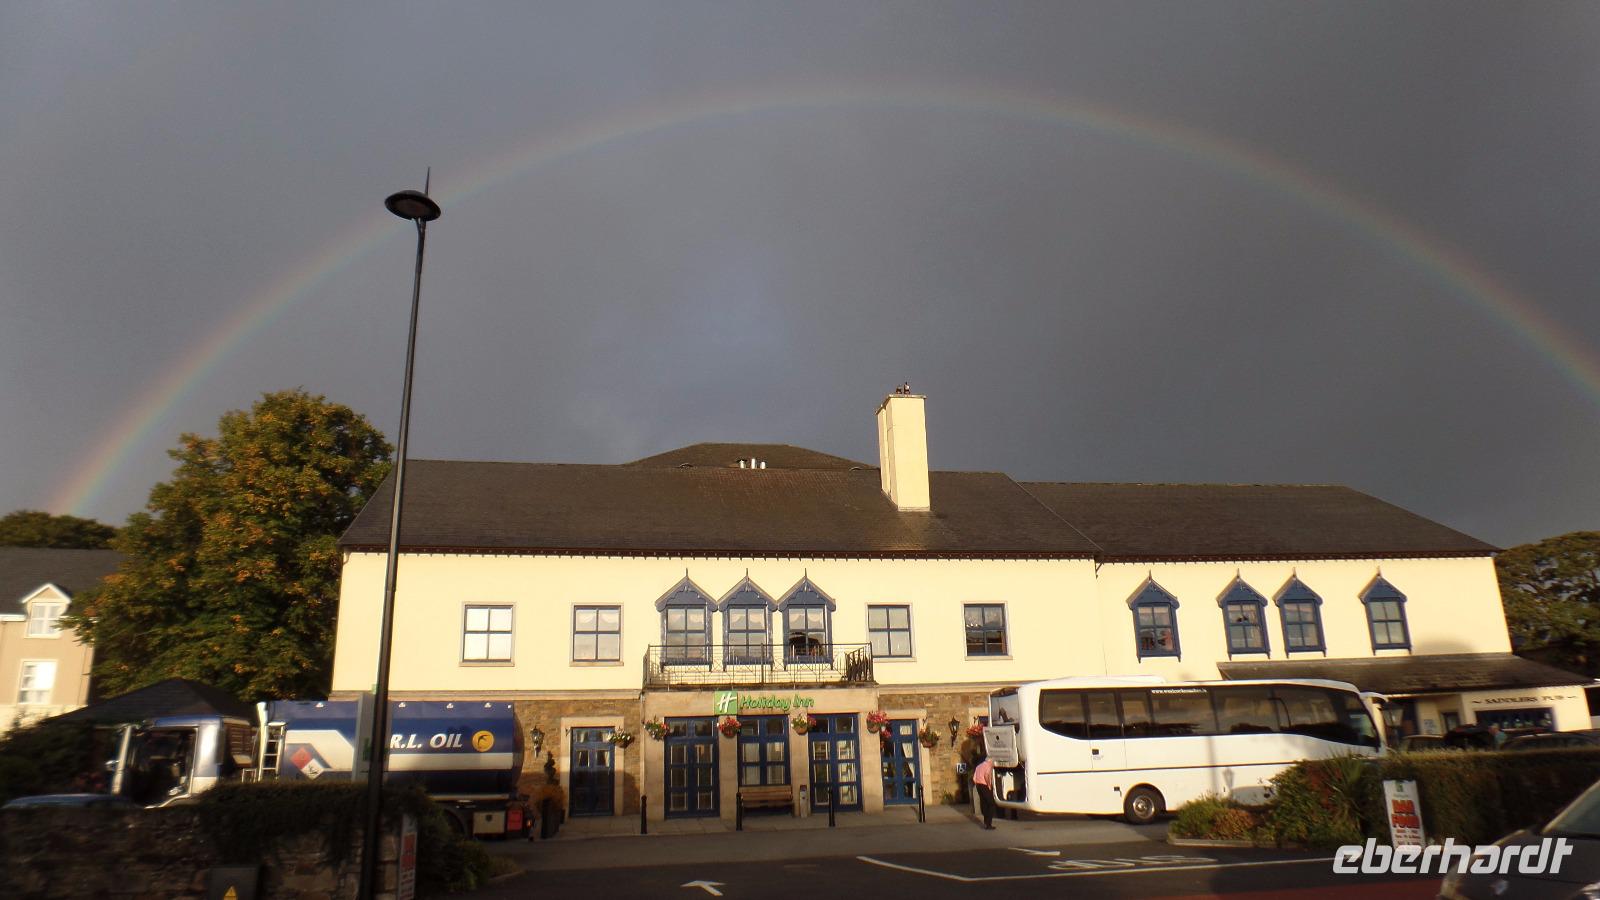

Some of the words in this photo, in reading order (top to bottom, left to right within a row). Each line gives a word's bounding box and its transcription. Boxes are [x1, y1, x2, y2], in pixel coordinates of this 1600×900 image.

[741, 694, 791, 711] Holiday
[793, 694, 814, 708] Inn
[429, 733, 463, 749] OIL
